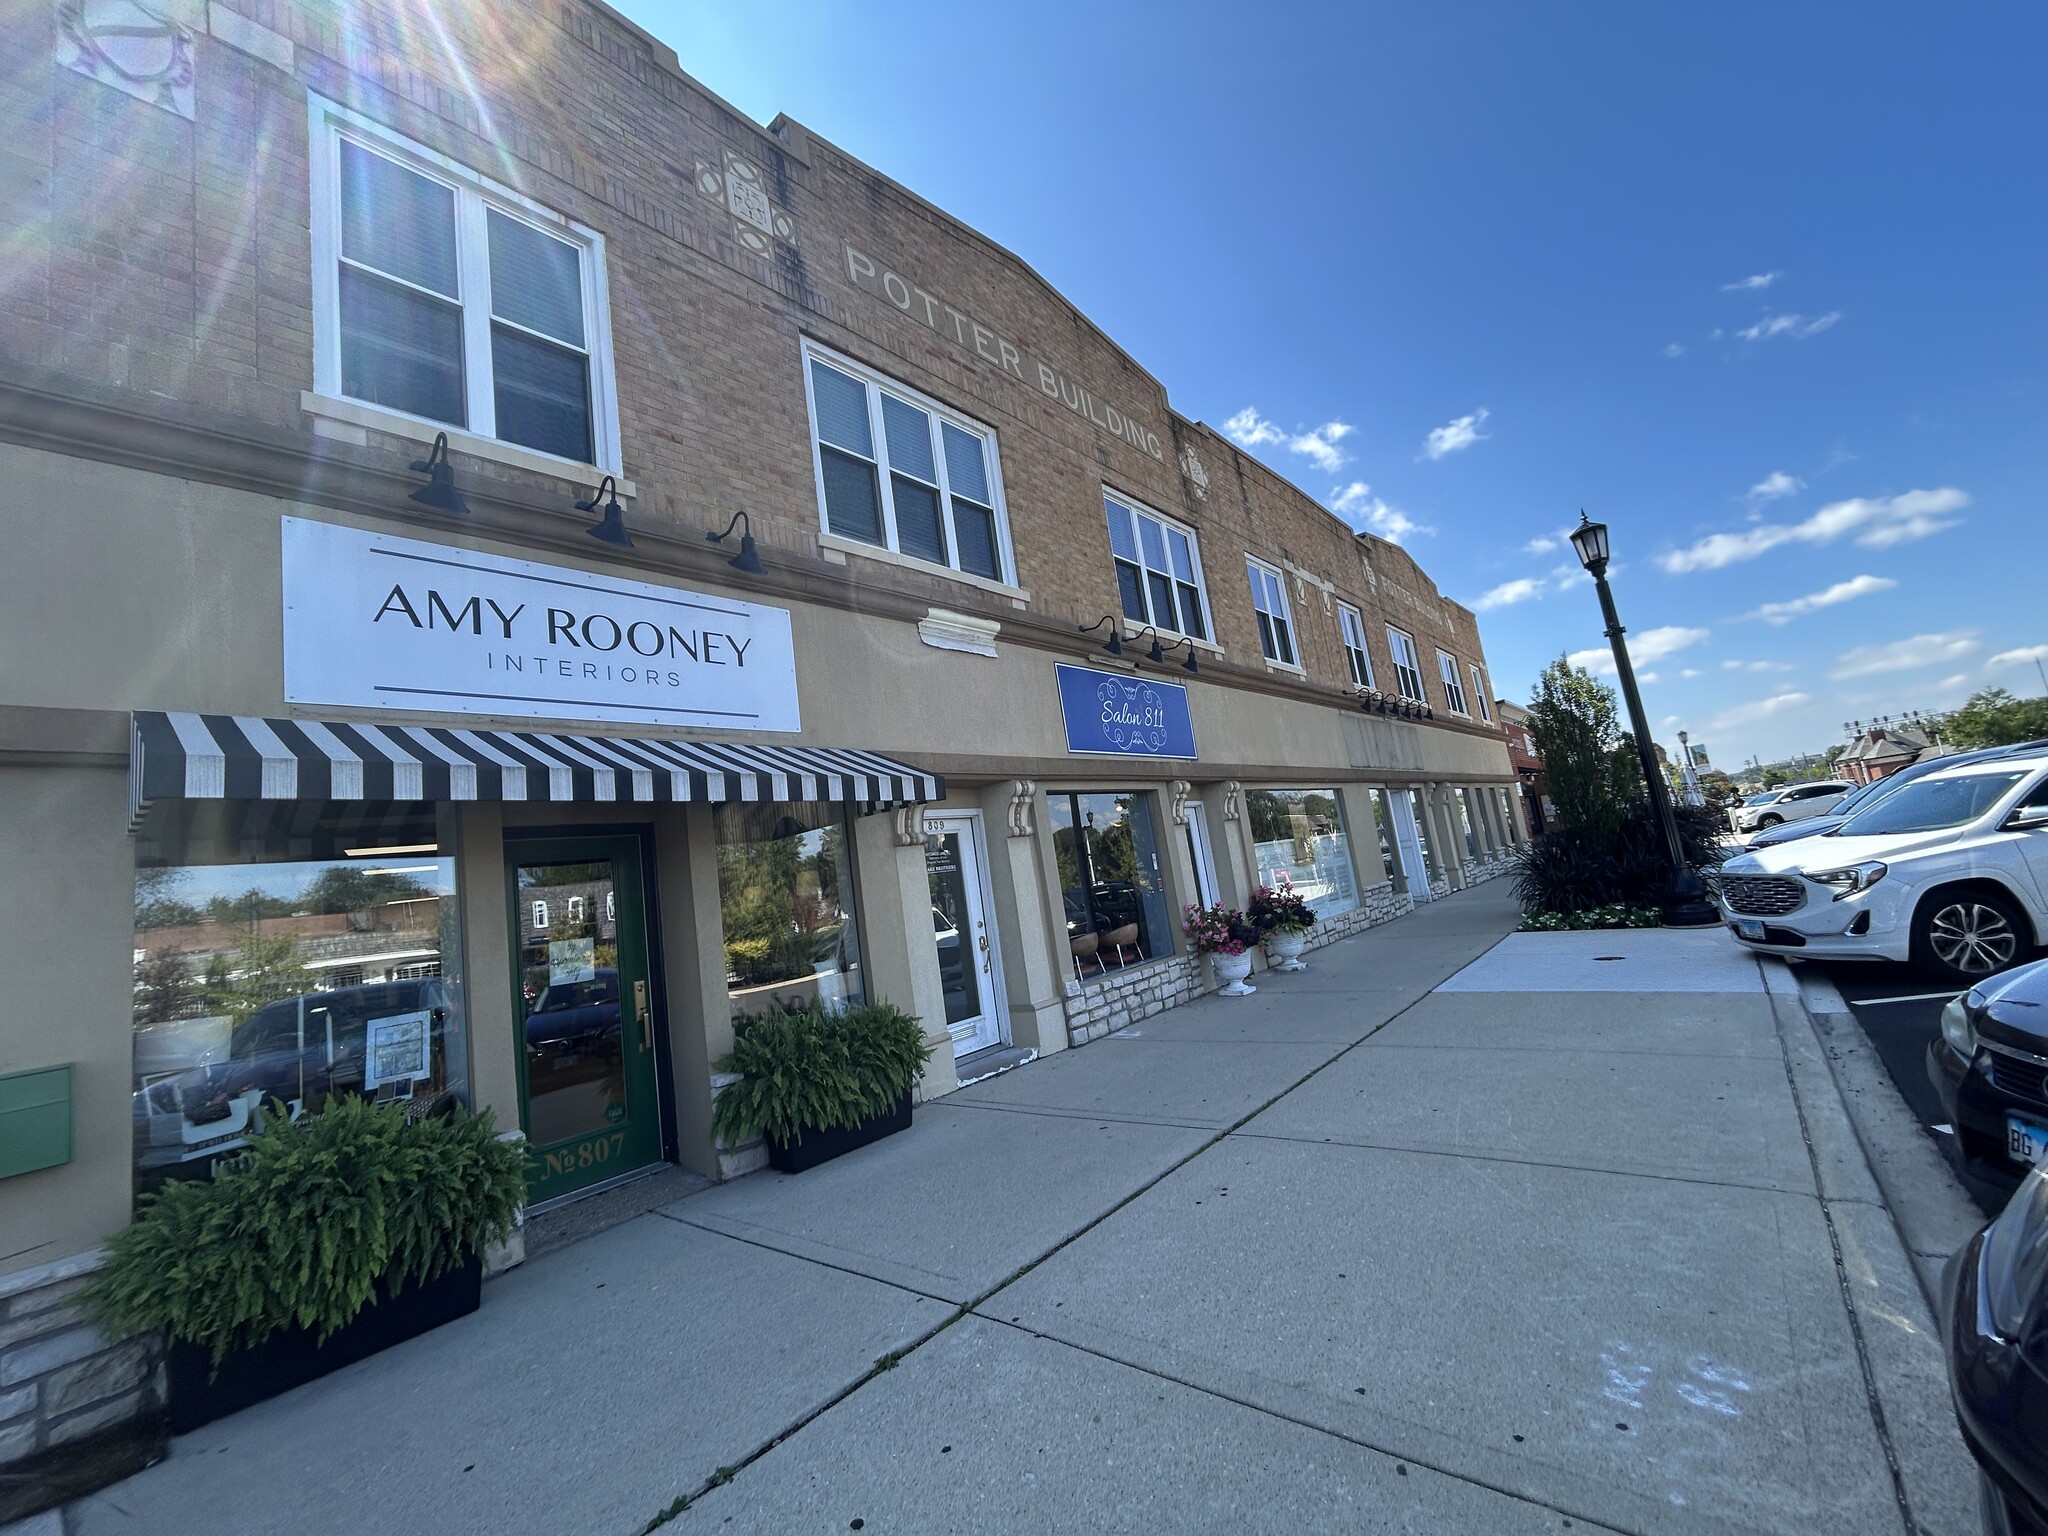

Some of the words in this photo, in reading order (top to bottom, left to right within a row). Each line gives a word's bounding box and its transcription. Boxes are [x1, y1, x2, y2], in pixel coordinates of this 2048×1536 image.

[845, 244, 1024, 379] POTTER
[1037, 361, 1164, 461] BUILDING
[372, 583, 526, 640] AMY
[546, 606, 752, 668] ROONEY
[487, 651, 682, 688] INTERIORS
[1101, 700, 1142, 726] Salon
[1144, 706, 1165, 728] 811
[927, 820, 945, 831] 809
[2011, 1128, 2033, 1157] BG
